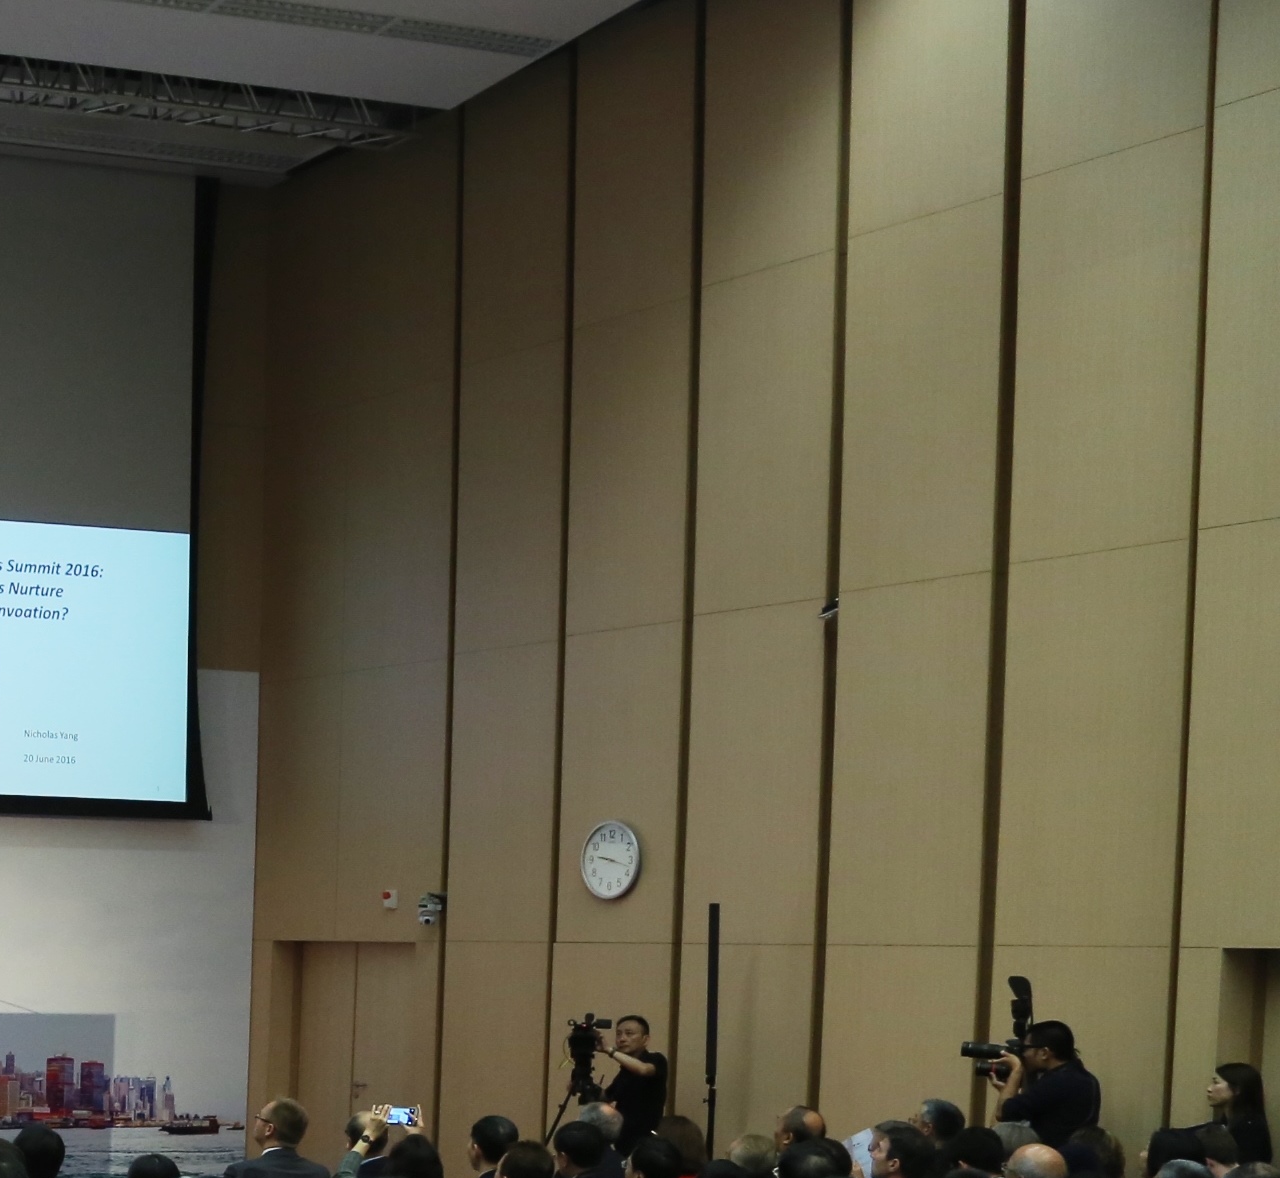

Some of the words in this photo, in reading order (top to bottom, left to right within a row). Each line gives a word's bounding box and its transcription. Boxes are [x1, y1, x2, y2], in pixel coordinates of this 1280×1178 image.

[6, 559, 62, 576] Summit
[64, 562, 104, 579] 2016:
[8, 581, 64, 598] Nurture
[23, 729, 58, 740] Nicholas
[59, 731, 79, 742] Yang
[23, 754, 34, 763] 20
[35, 755, 55, 764] June
[55, 755, 76, 765] 2016
